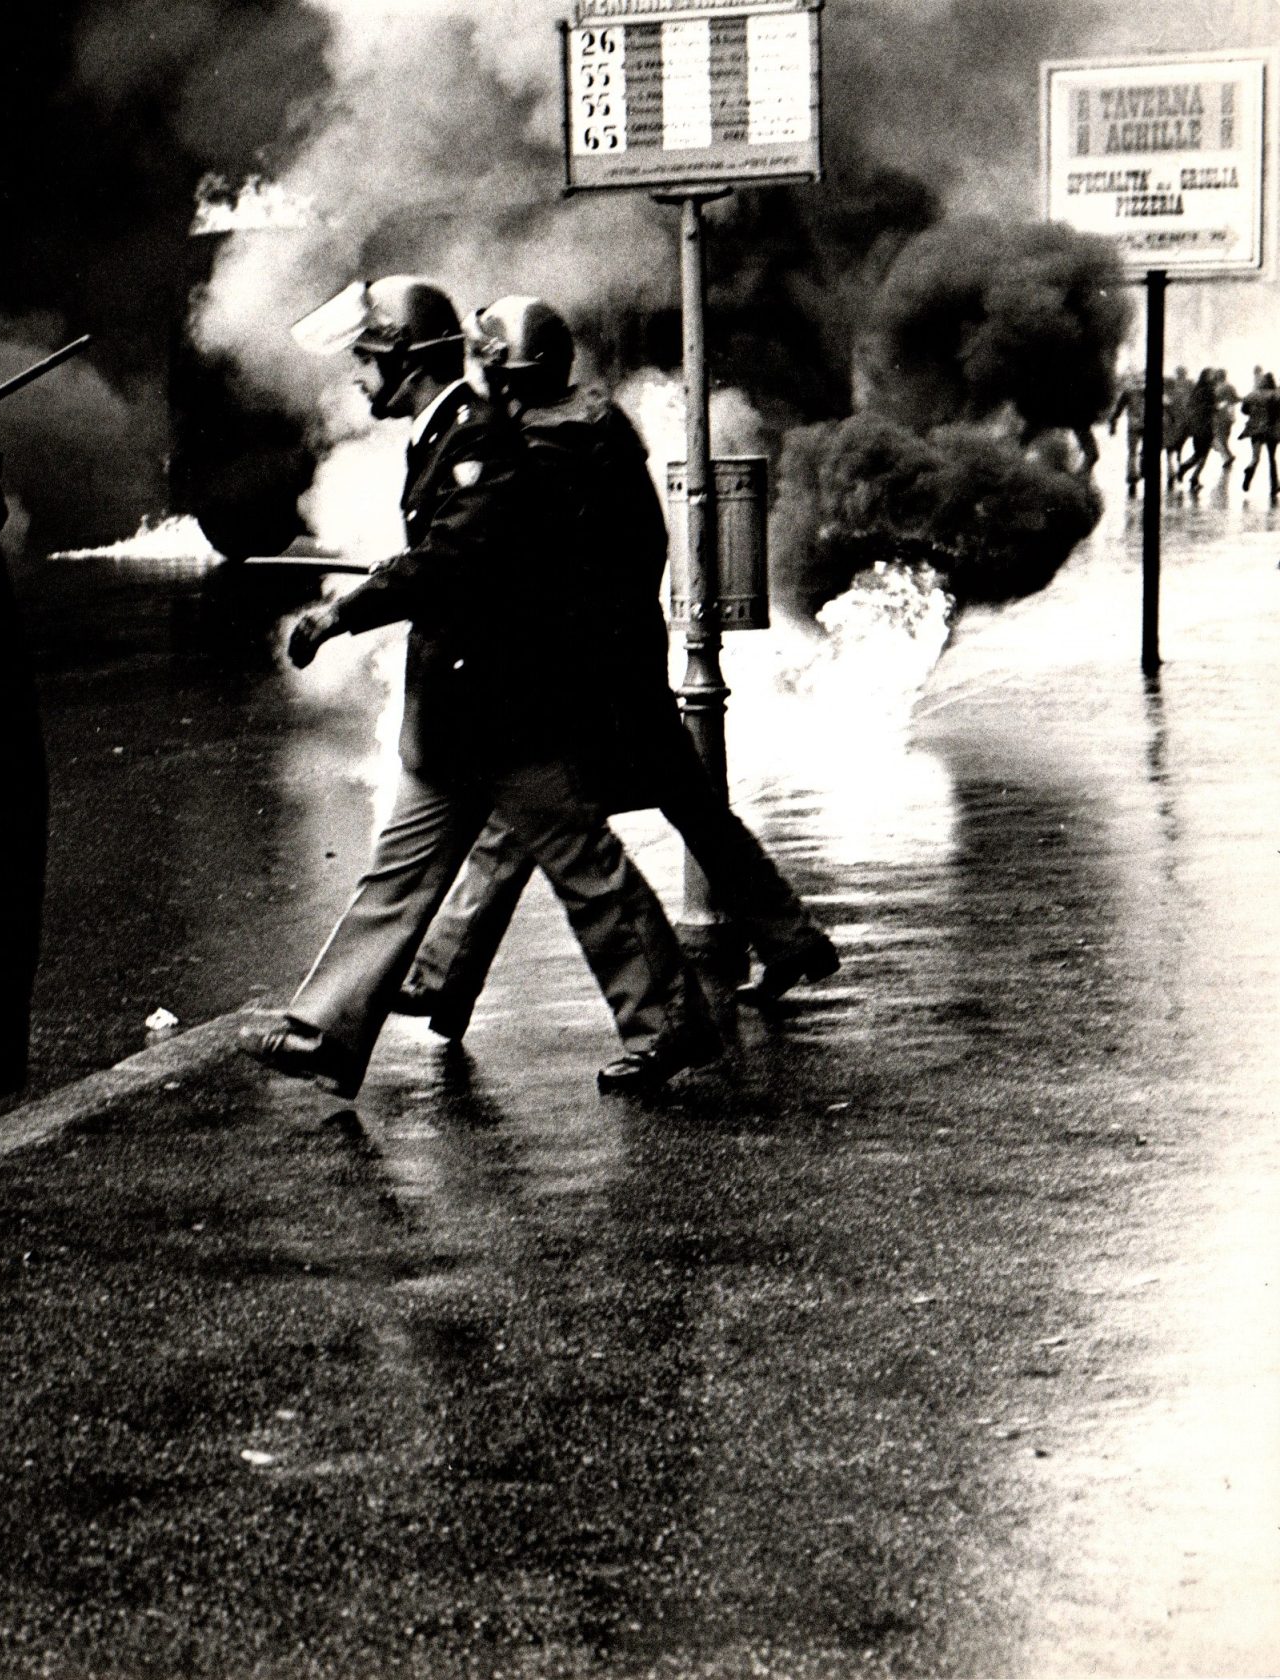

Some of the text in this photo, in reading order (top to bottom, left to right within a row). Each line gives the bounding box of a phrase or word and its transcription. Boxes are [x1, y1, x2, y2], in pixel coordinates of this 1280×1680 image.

[581, 30, 615, 56] 26
[581, 63, 610, 88] 55
[581, 92, 611, 118] 55
[1100, 83, 1205, 120] TAVERNA
[584, 125, 618, 150] 65
[1105, 119, 1202, 153] ACHILLE
[1115, 194, 1184, 217] PIZZERIA
